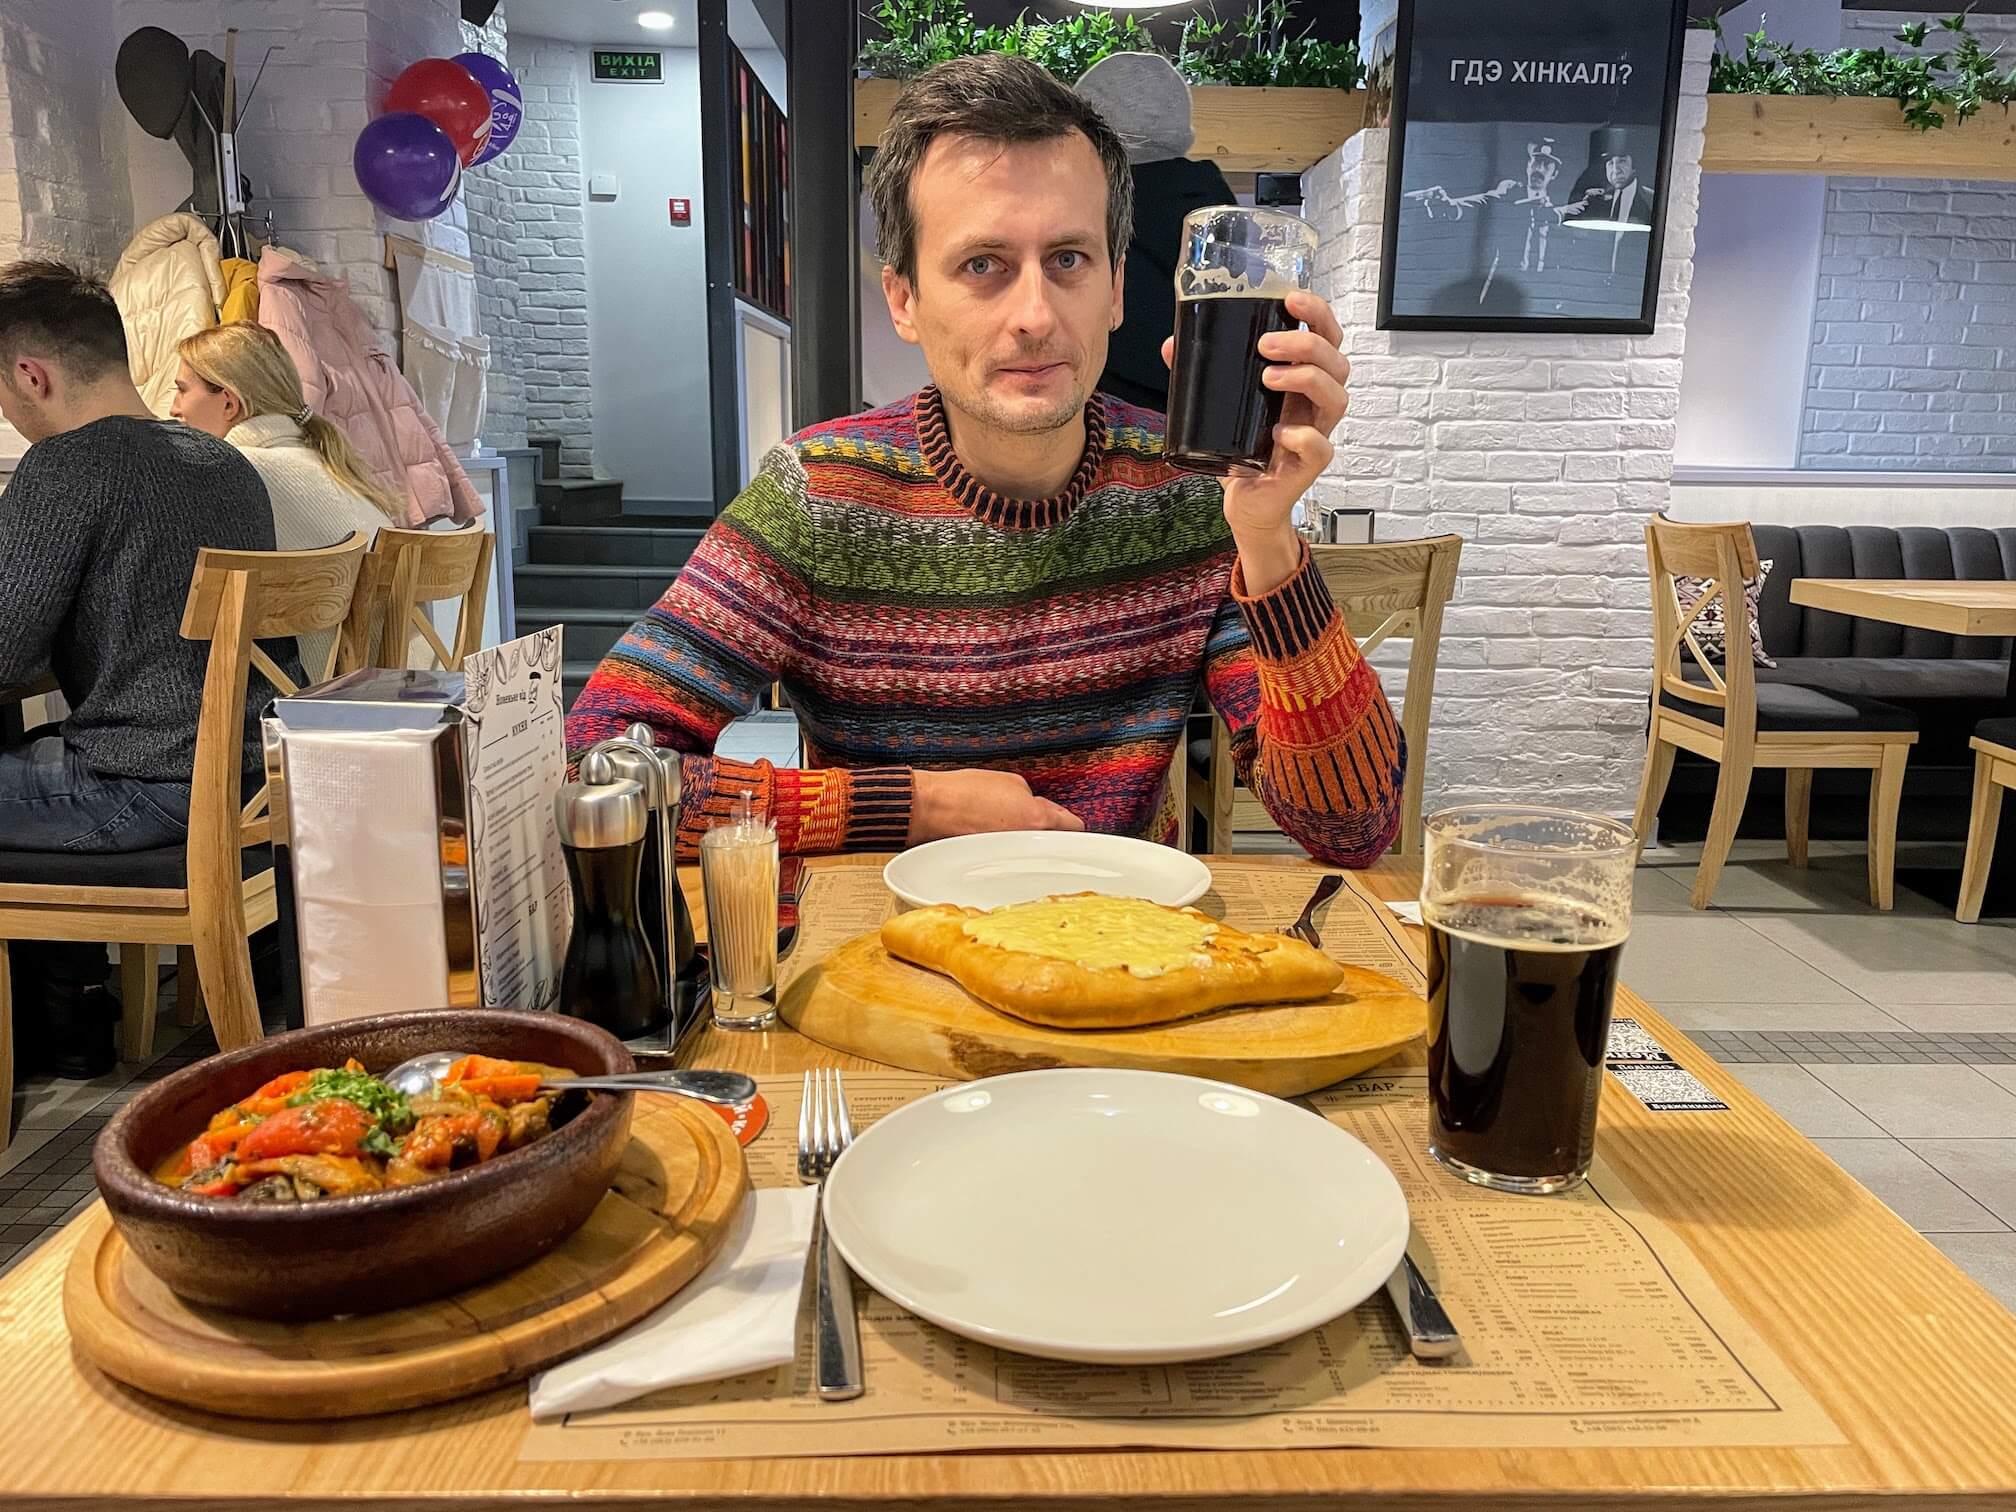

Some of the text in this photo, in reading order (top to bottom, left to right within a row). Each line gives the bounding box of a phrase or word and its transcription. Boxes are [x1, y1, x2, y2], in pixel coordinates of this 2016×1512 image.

[600, 55, 656, 67] ВИХІД
[609, 68, 648, 77] EXIT
[1450, 59, 1633, 85] ГДЭ ХІНКАЛІ?
[1356, 1082, 1395, 1093] БАР
